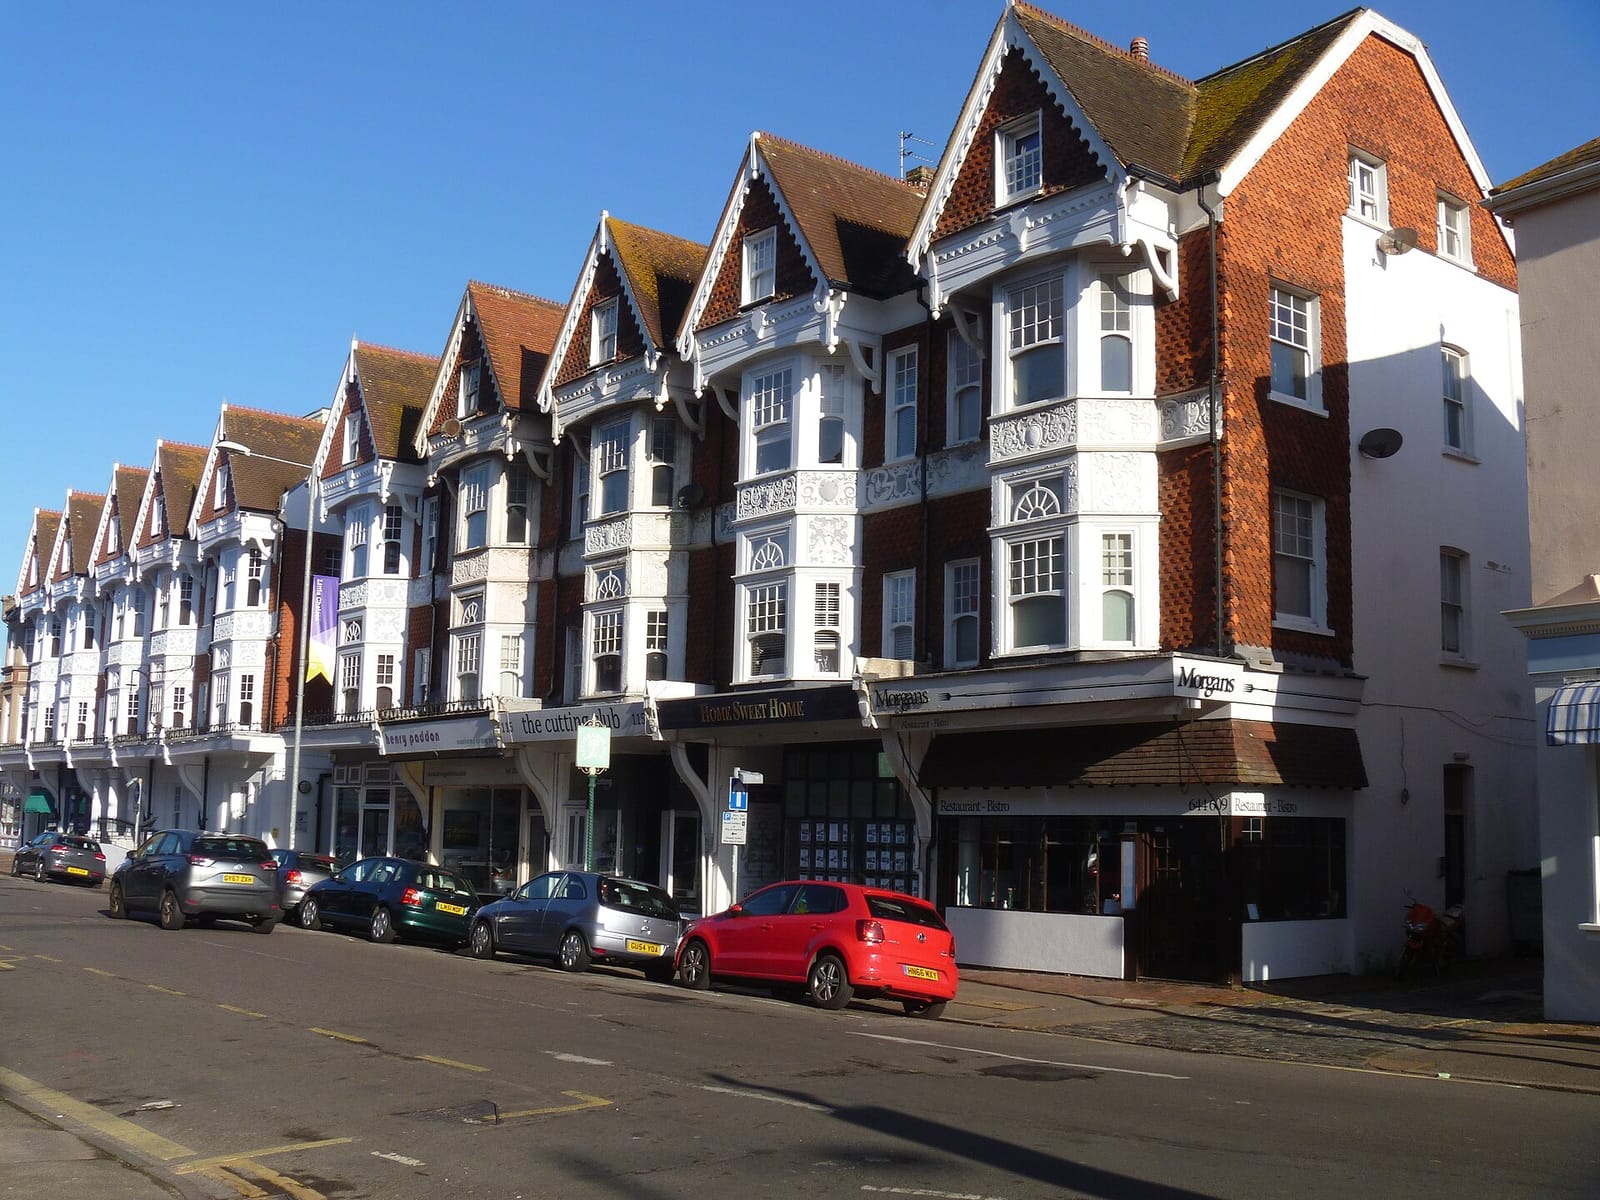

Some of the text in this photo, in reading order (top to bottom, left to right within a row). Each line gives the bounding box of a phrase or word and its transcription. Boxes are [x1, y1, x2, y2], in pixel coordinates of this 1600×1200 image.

[1178, 667, 1235, 697] Morgans
[874, 689, 929, 711] Morgans
[521, 714, 542, 734] the
[384, 733, 407, 747] henry
[409, 731, 440, 745] paddon
[940, 800, 980, 811] Restaurant
[987, 800, 1009, 811] Bistro
[630, 942, 645, 951] GU54
